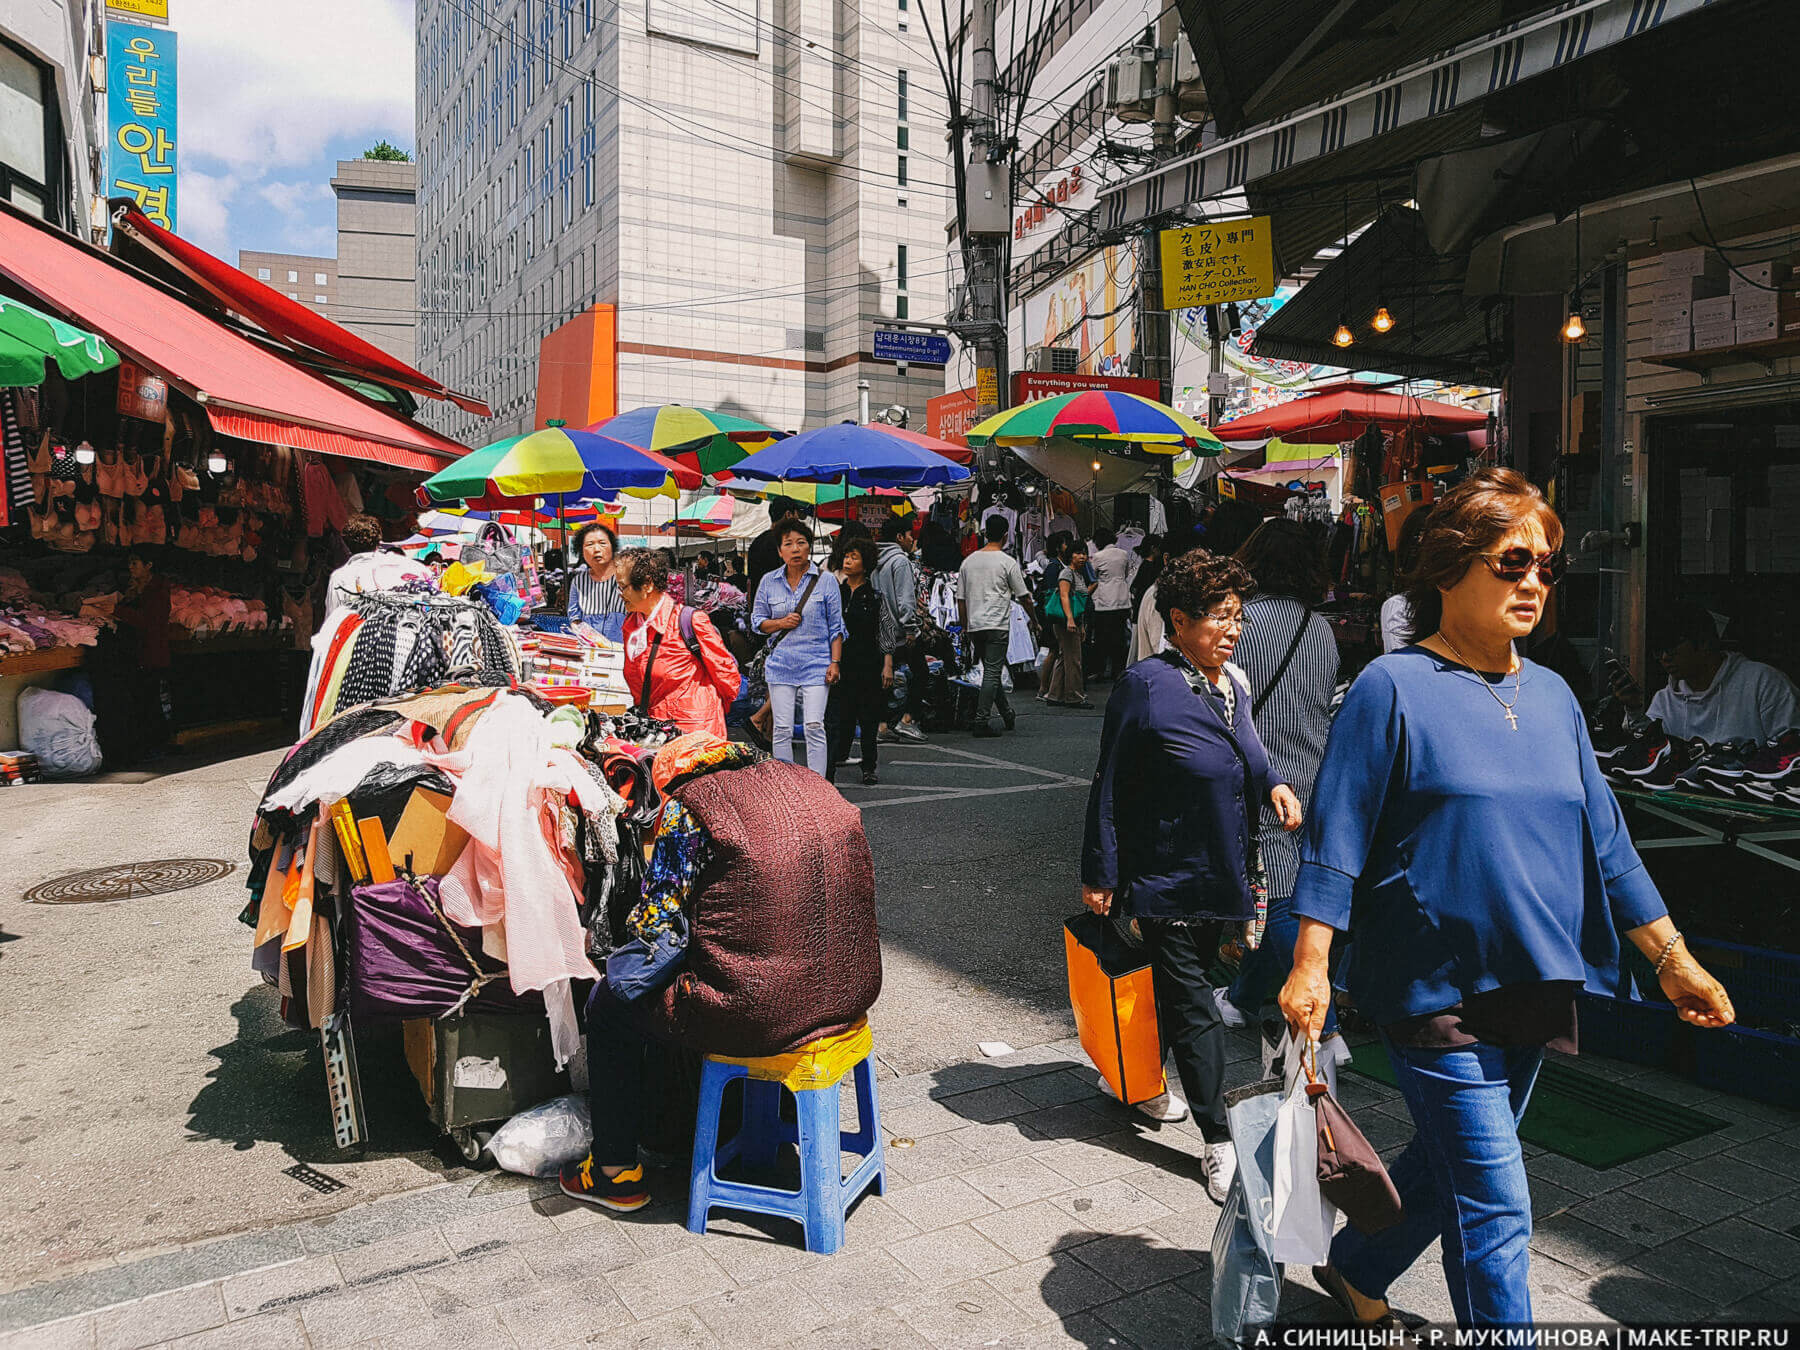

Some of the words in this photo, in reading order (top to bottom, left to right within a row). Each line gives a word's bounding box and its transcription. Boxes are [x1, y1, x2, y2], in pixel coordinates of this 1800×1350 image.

[123, 36, 161, 118] 우리들
[114, 122, 175, 232] 안경
[1179, 283, 1197, 293] HAN
[1198, 281, 1217, 291] CHO
[1218, 277, 1257, 288] Collection
[1027, 378, 1071, 388] Everything
[1072, 381, 1087, 389] you
